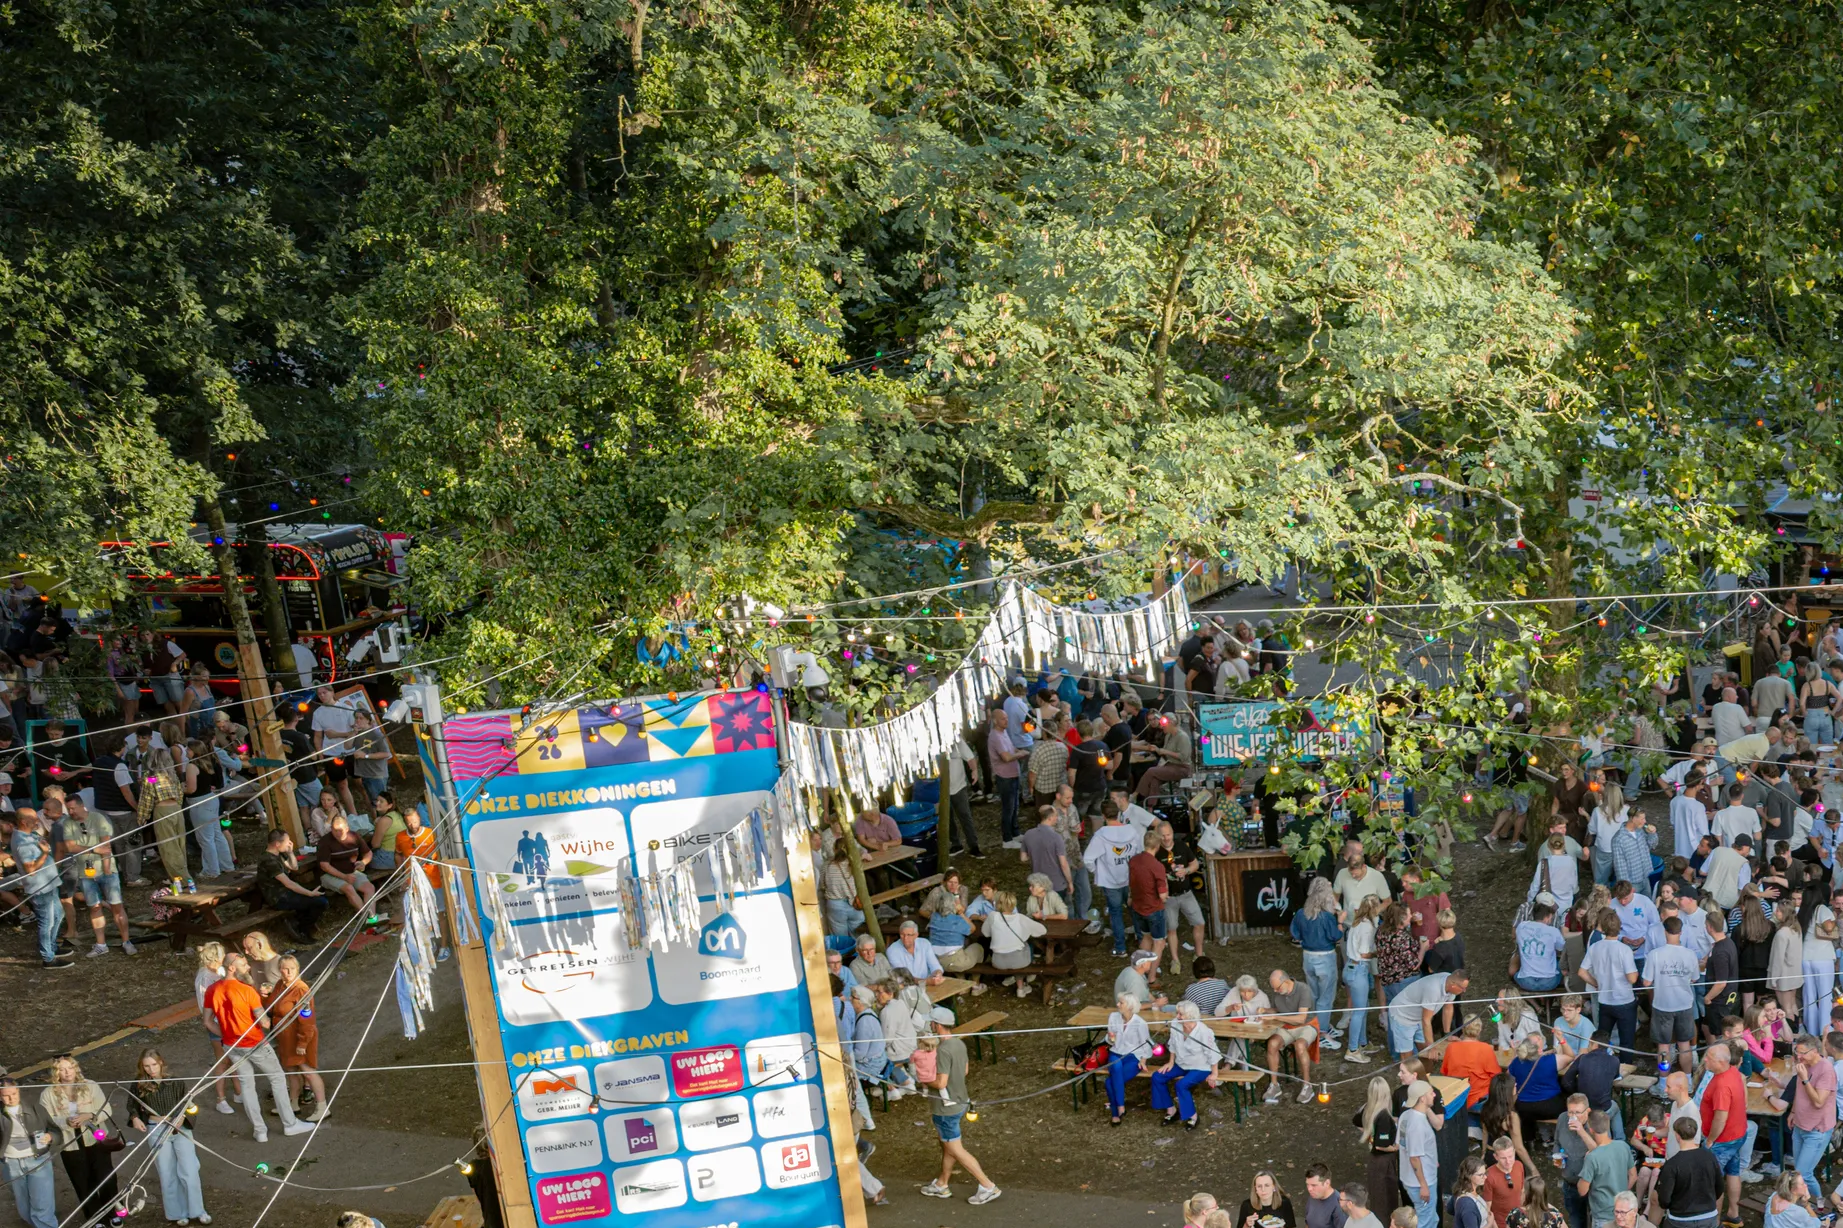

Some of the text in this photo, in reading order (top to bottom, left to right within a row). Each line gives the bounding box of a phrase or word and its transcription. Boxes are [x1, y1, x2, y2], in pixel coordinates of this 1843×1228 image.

[538, 745, 562, 761] 26
[465, 778, 677, 816] ONZE DIEKKONINGEN
[561, 840, 615, 857] Wijhe
[663, 833, 711, 849] BIKE
[545, 893, 580, 905] genieten
[508, 957, 598, 977] GERRETSEN
[700, 965, 762, 981] Boomgaard
[512, 1029, 689, 1067] ONZE DIEKGRAVEN
[676, 1048, 734, 1069] UW LOGO
[691, 1062, 725, 1078] HIER?
[537, 1106, 557, 1114] GEBR.
[717, 1116, 738, 1124] LAND
[534, 1142, 577, 1153] PENN&INK
[630, 1132, 655, 1149] pci
[783, 1147, 809, 1168] da
[542, 1176, 601, 1196] UW LOGO
[557, 1189, 592, 1204] HIER?
